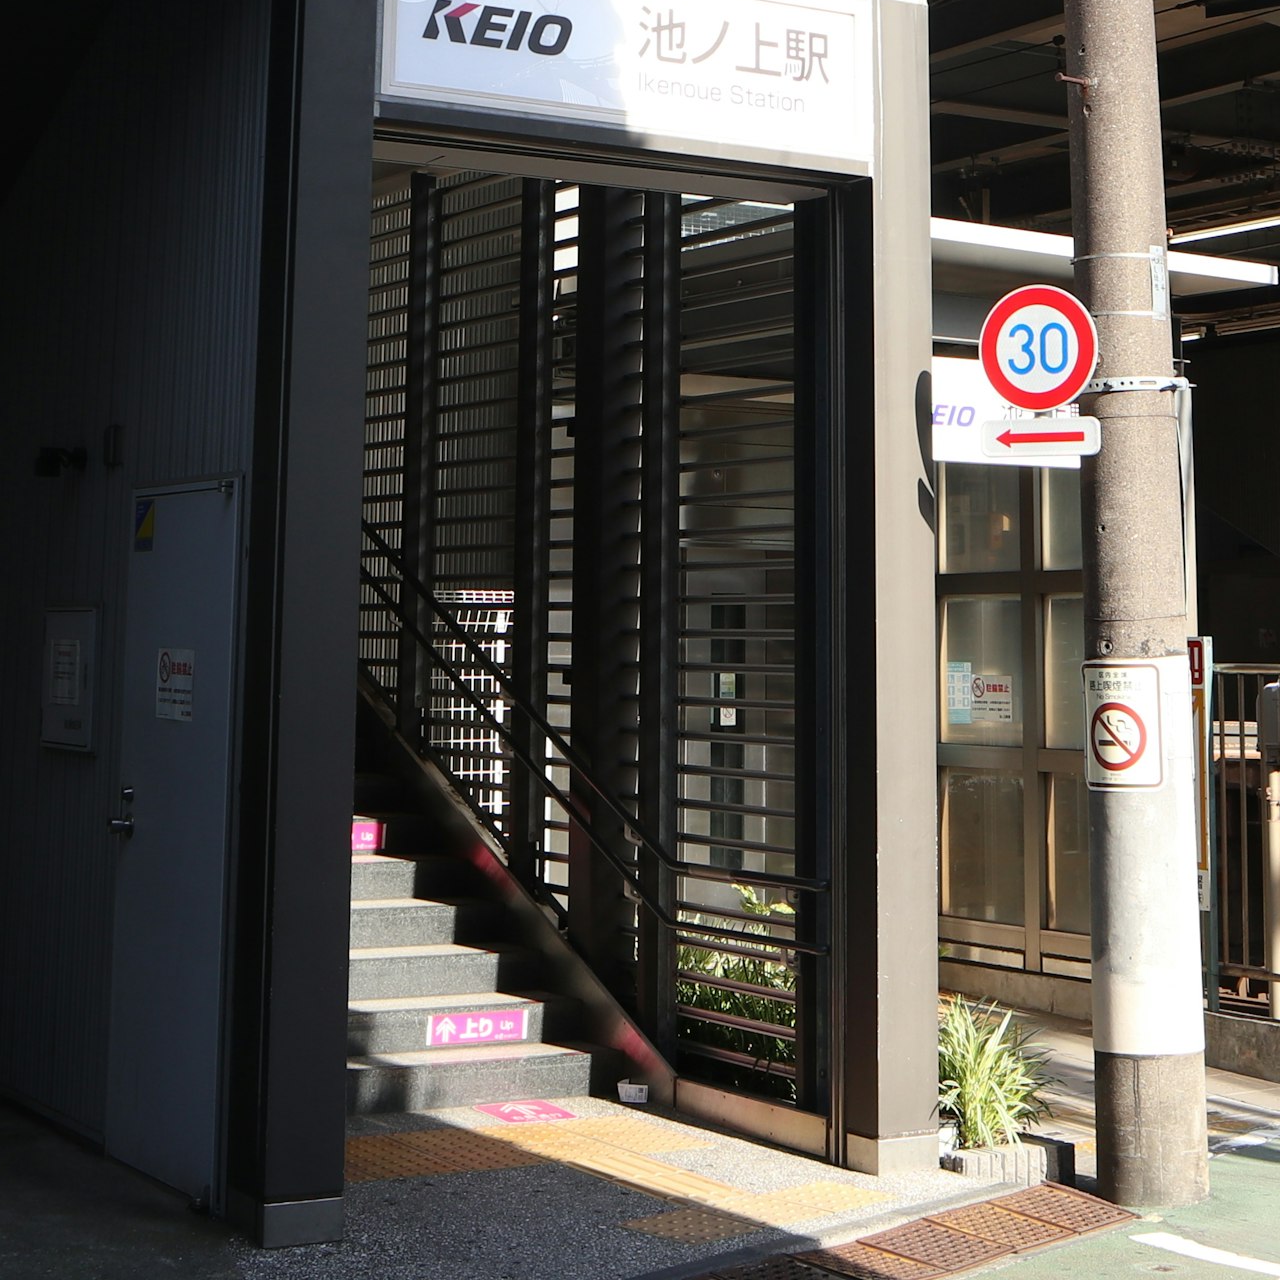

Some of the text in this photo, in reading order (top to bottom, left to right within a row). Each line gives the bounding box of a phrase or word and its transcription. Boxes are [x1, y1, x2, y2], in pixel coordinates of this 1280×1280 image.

[637, 5, 830, 84] 池ノ上駅
[637, 71, 806, 113] Ikenoue Station
[1007, 322, 1069, 375] 30
[933, 404, 976, 427] EIO
[459, 1017, 514, 1038] 上り Up
